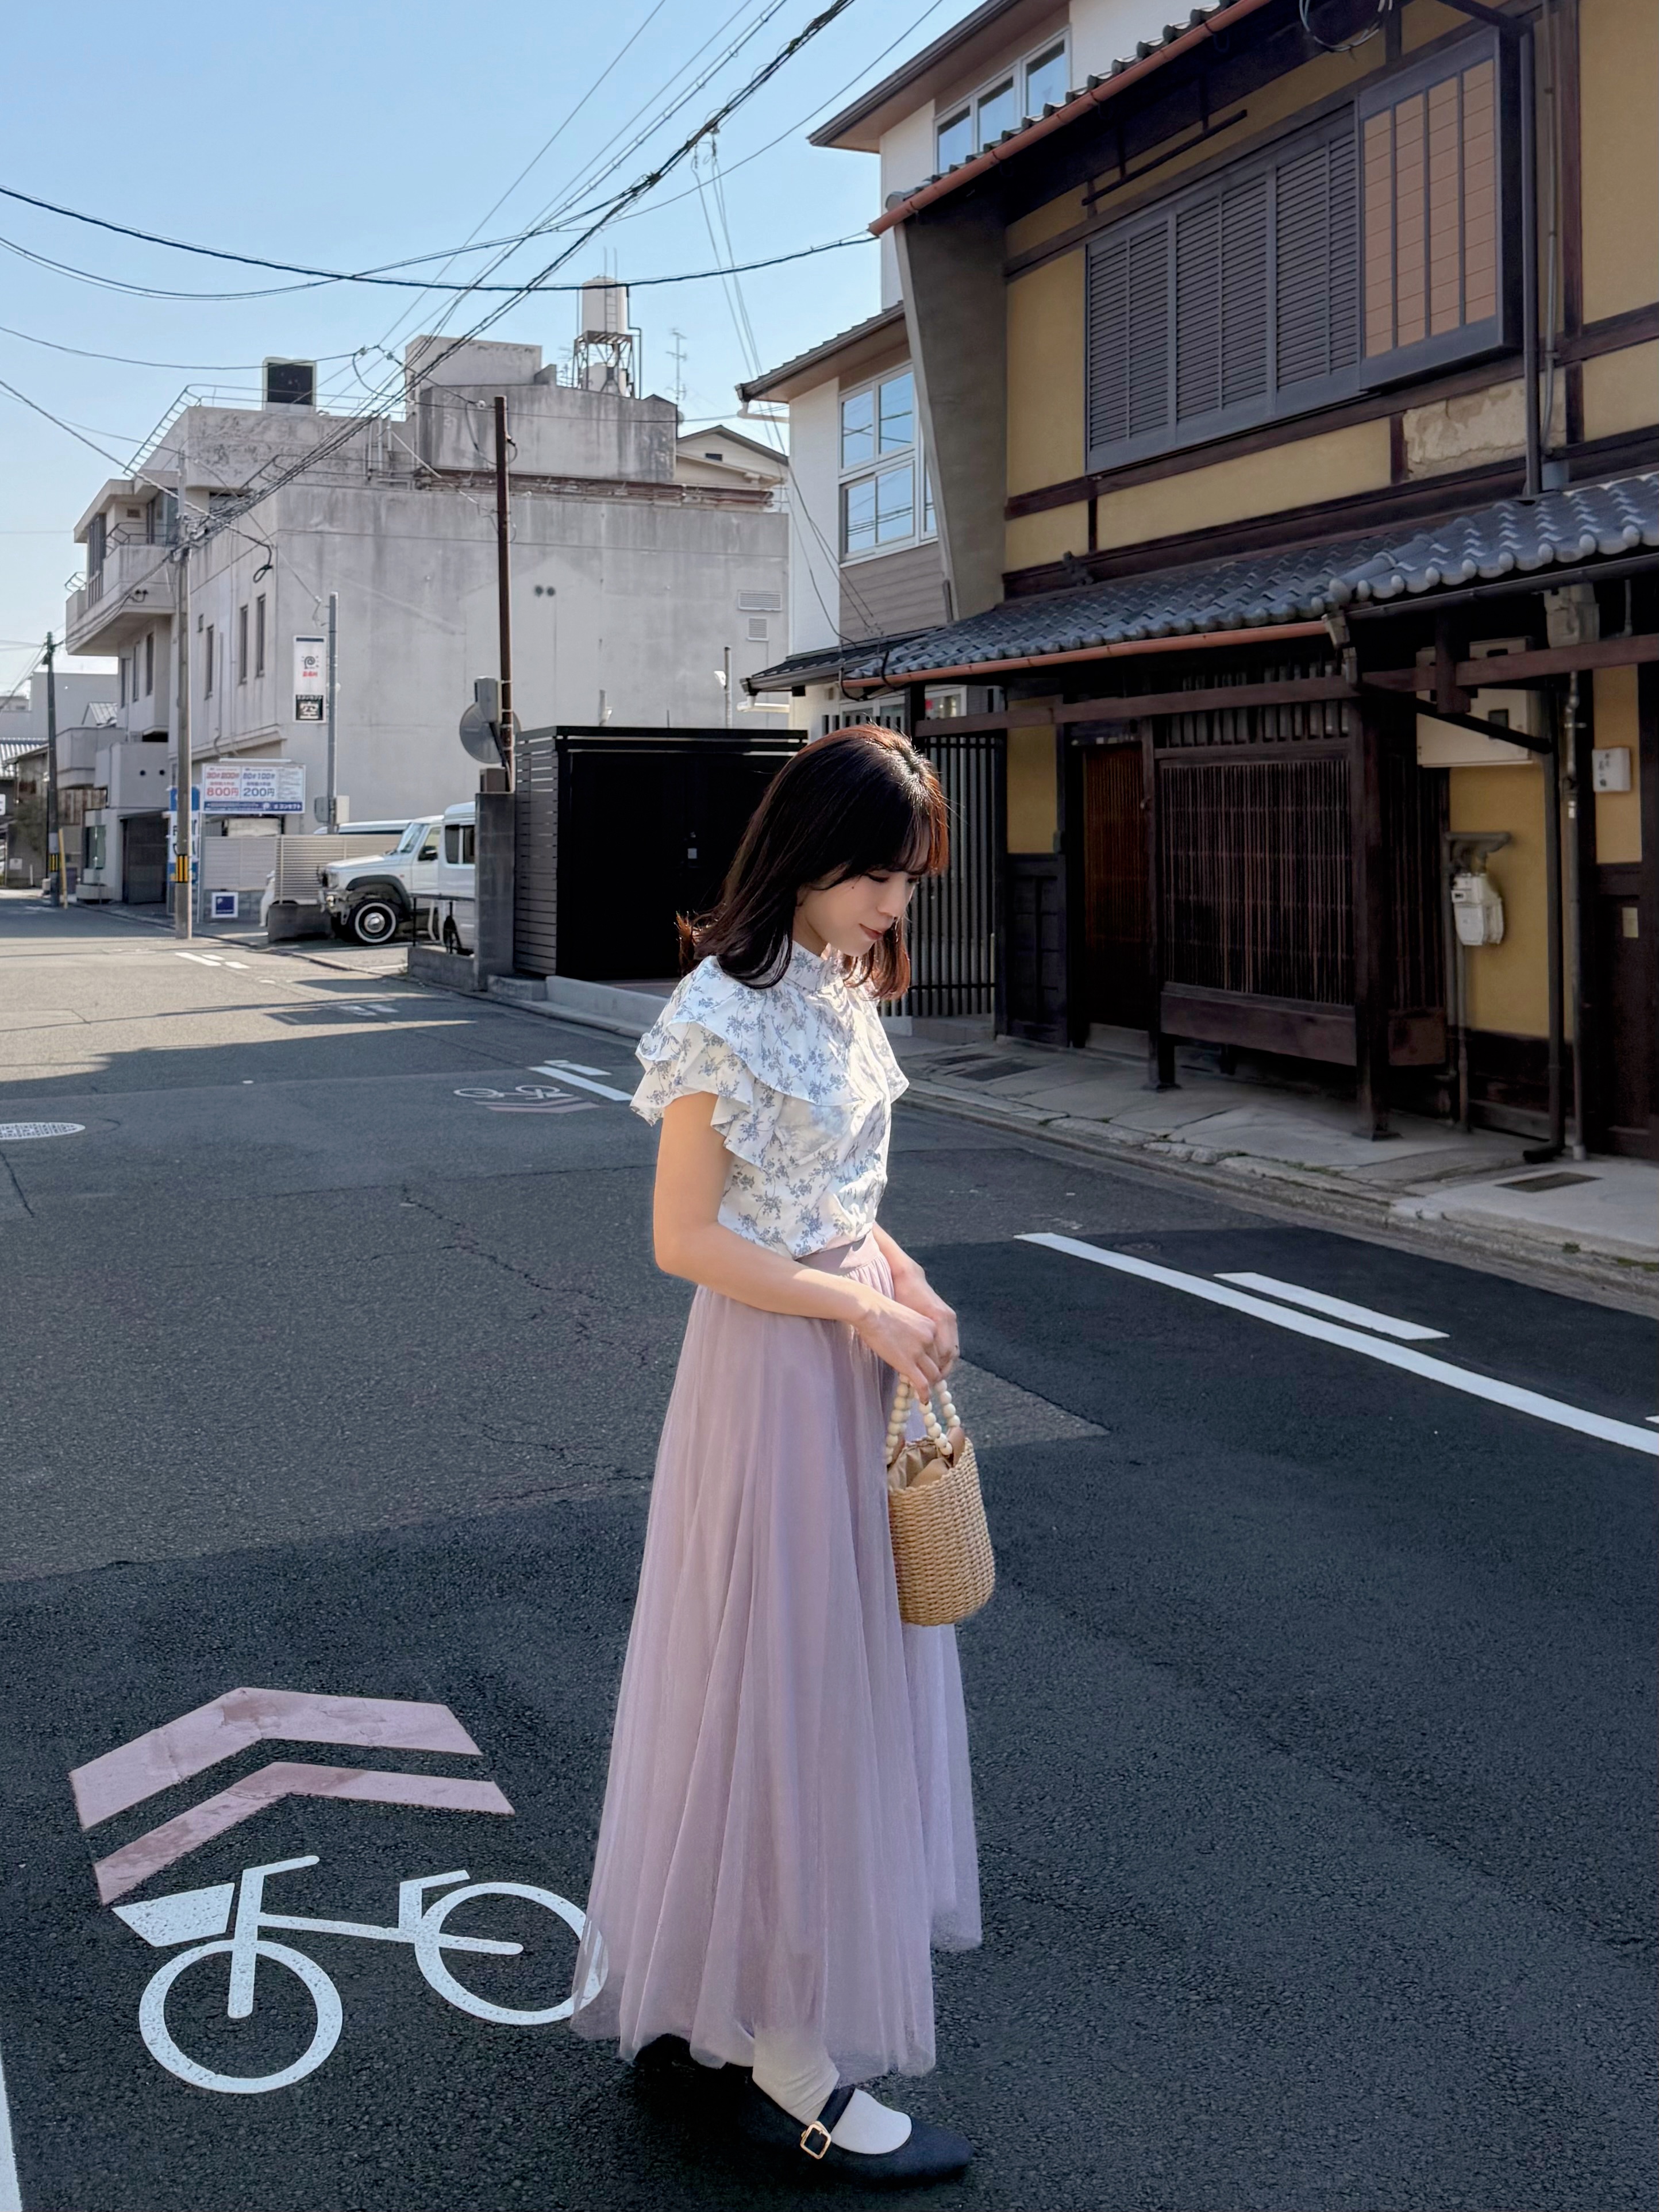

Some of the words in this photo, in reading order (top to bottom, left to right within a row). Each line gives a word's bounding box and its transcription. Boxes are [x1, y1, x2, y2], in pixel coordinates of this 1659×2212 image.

[299, 701, 319, 720] 空
[207, 787, 239, 797] 800円
[243, 788, 275, 797] 200円
